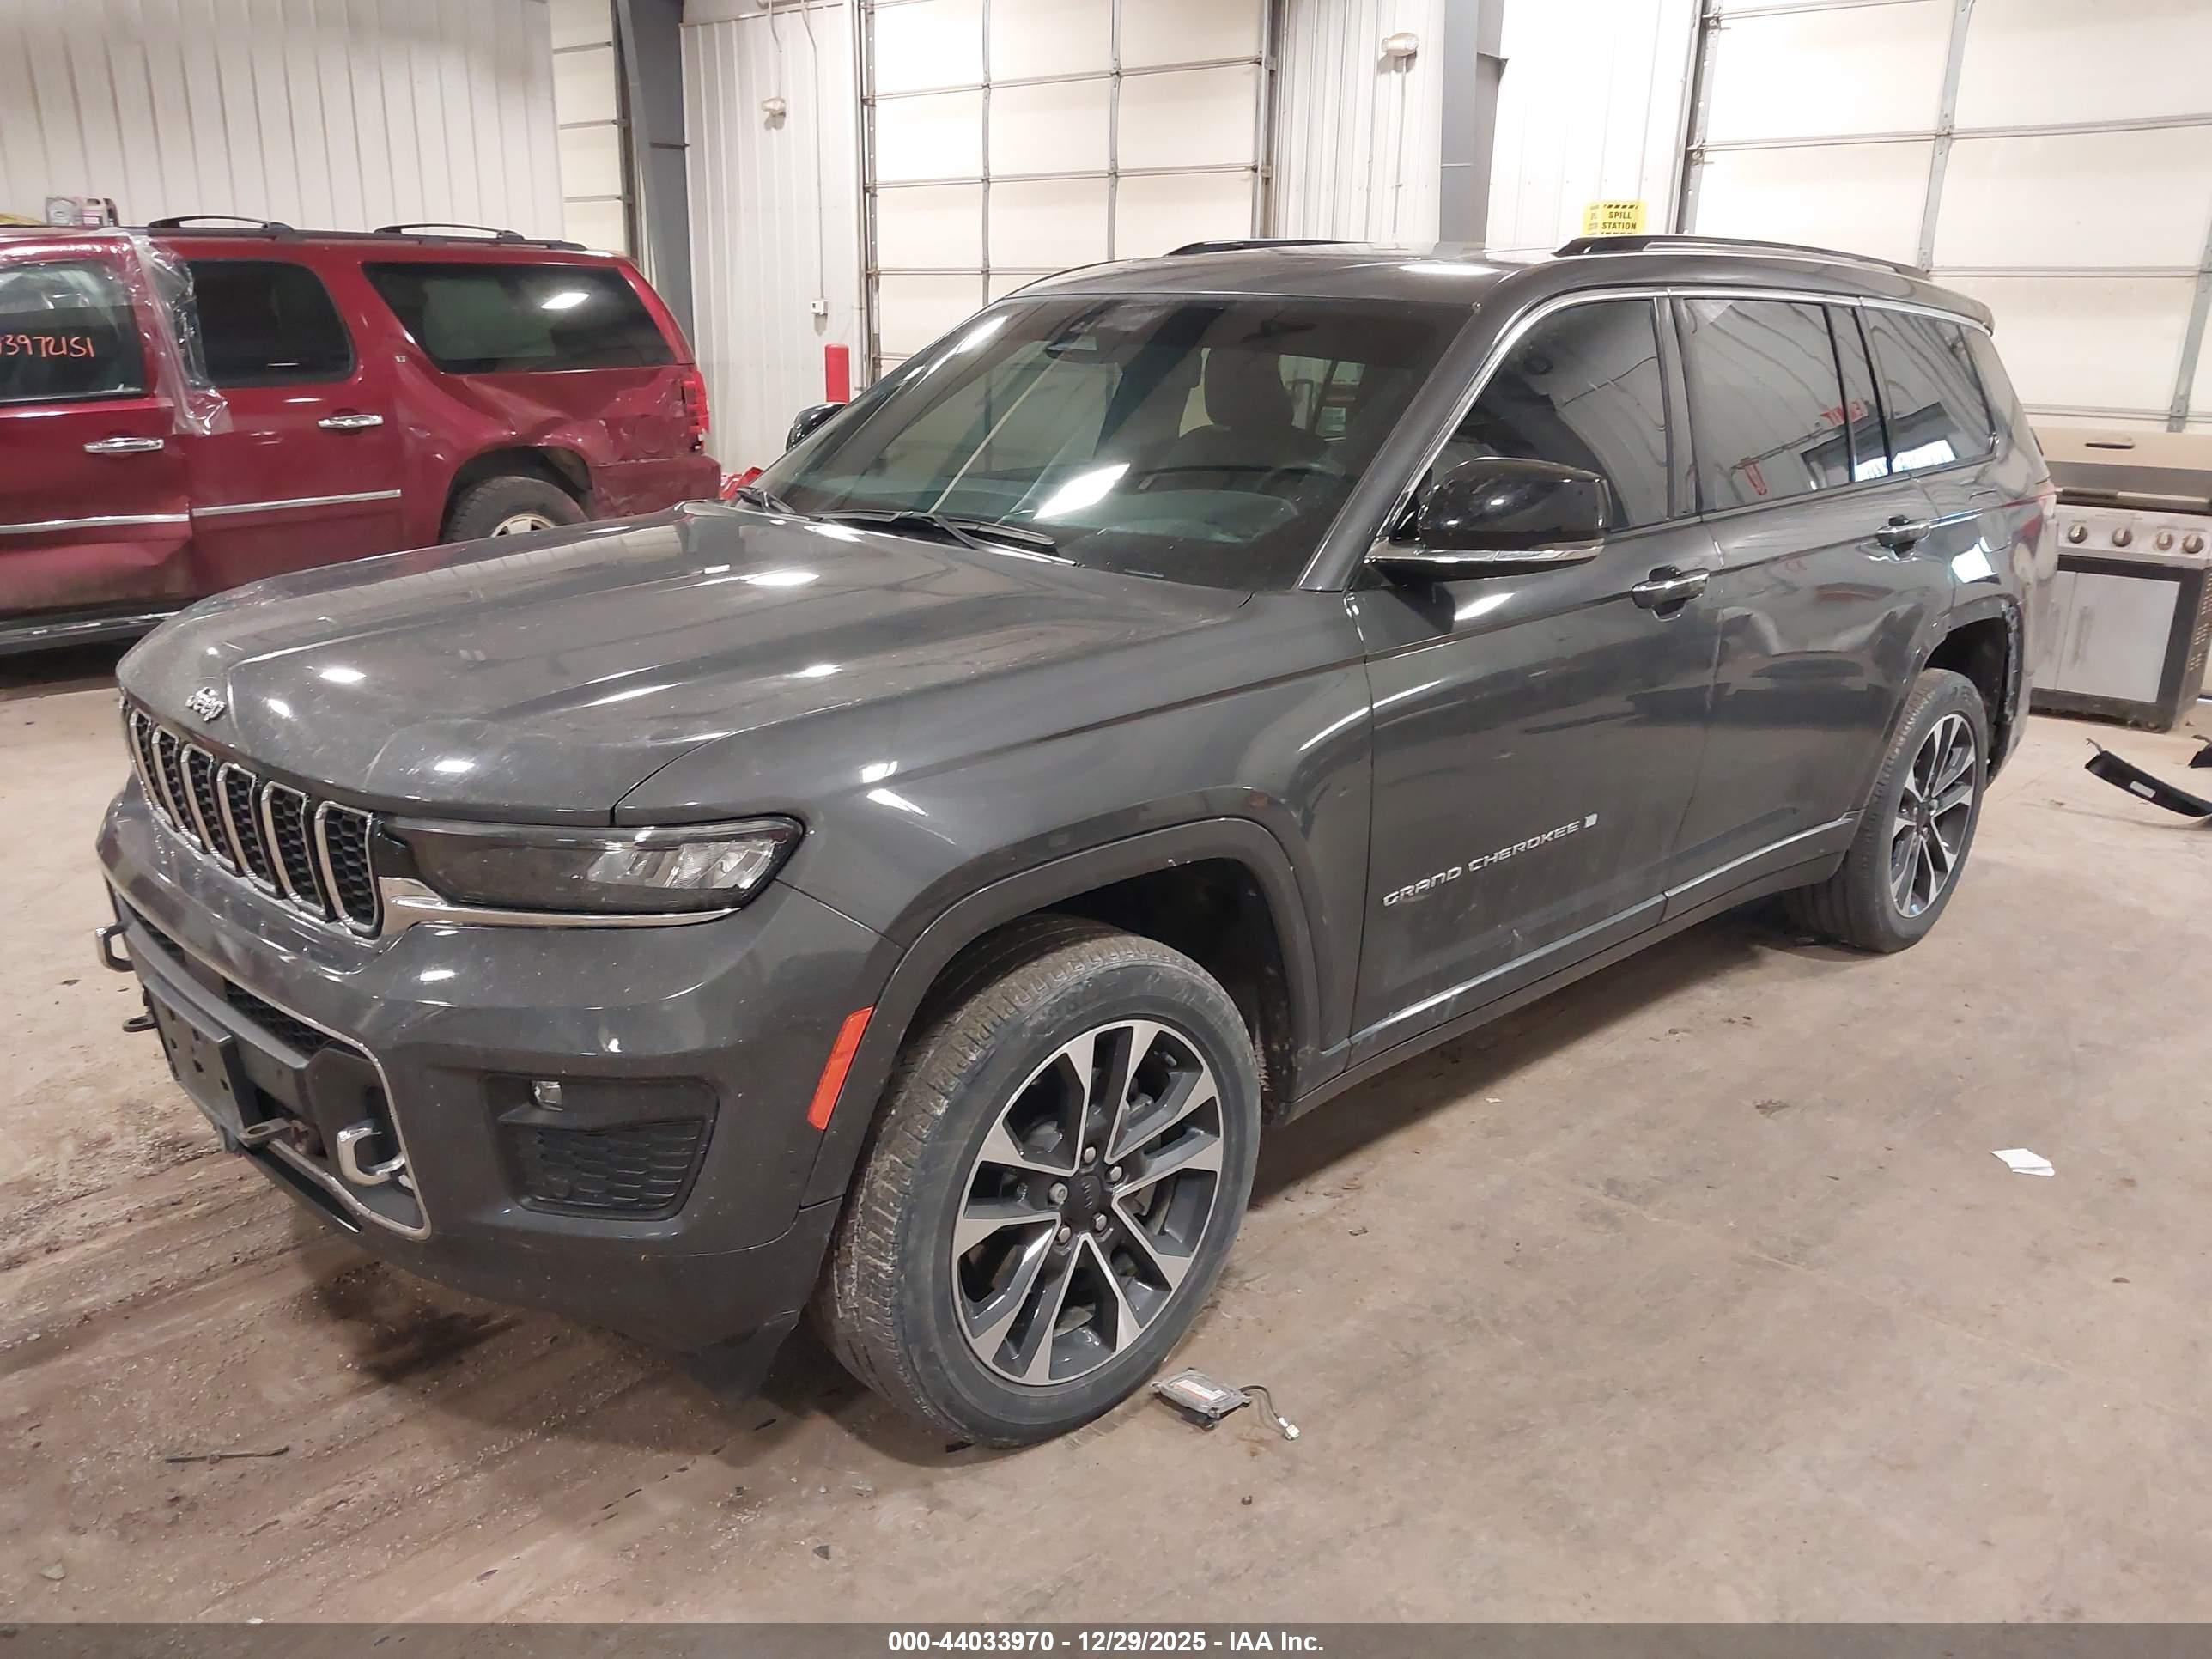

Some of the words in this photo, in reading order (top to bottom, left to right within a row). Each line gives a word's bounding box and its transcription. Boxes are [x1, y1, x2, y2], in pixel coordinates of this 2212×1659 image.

[0, 334, 94, 357] 3972151
[1383, 866, 1462, 907] GRAND
[1468, 820, 1580, 872] CHEROKEE
